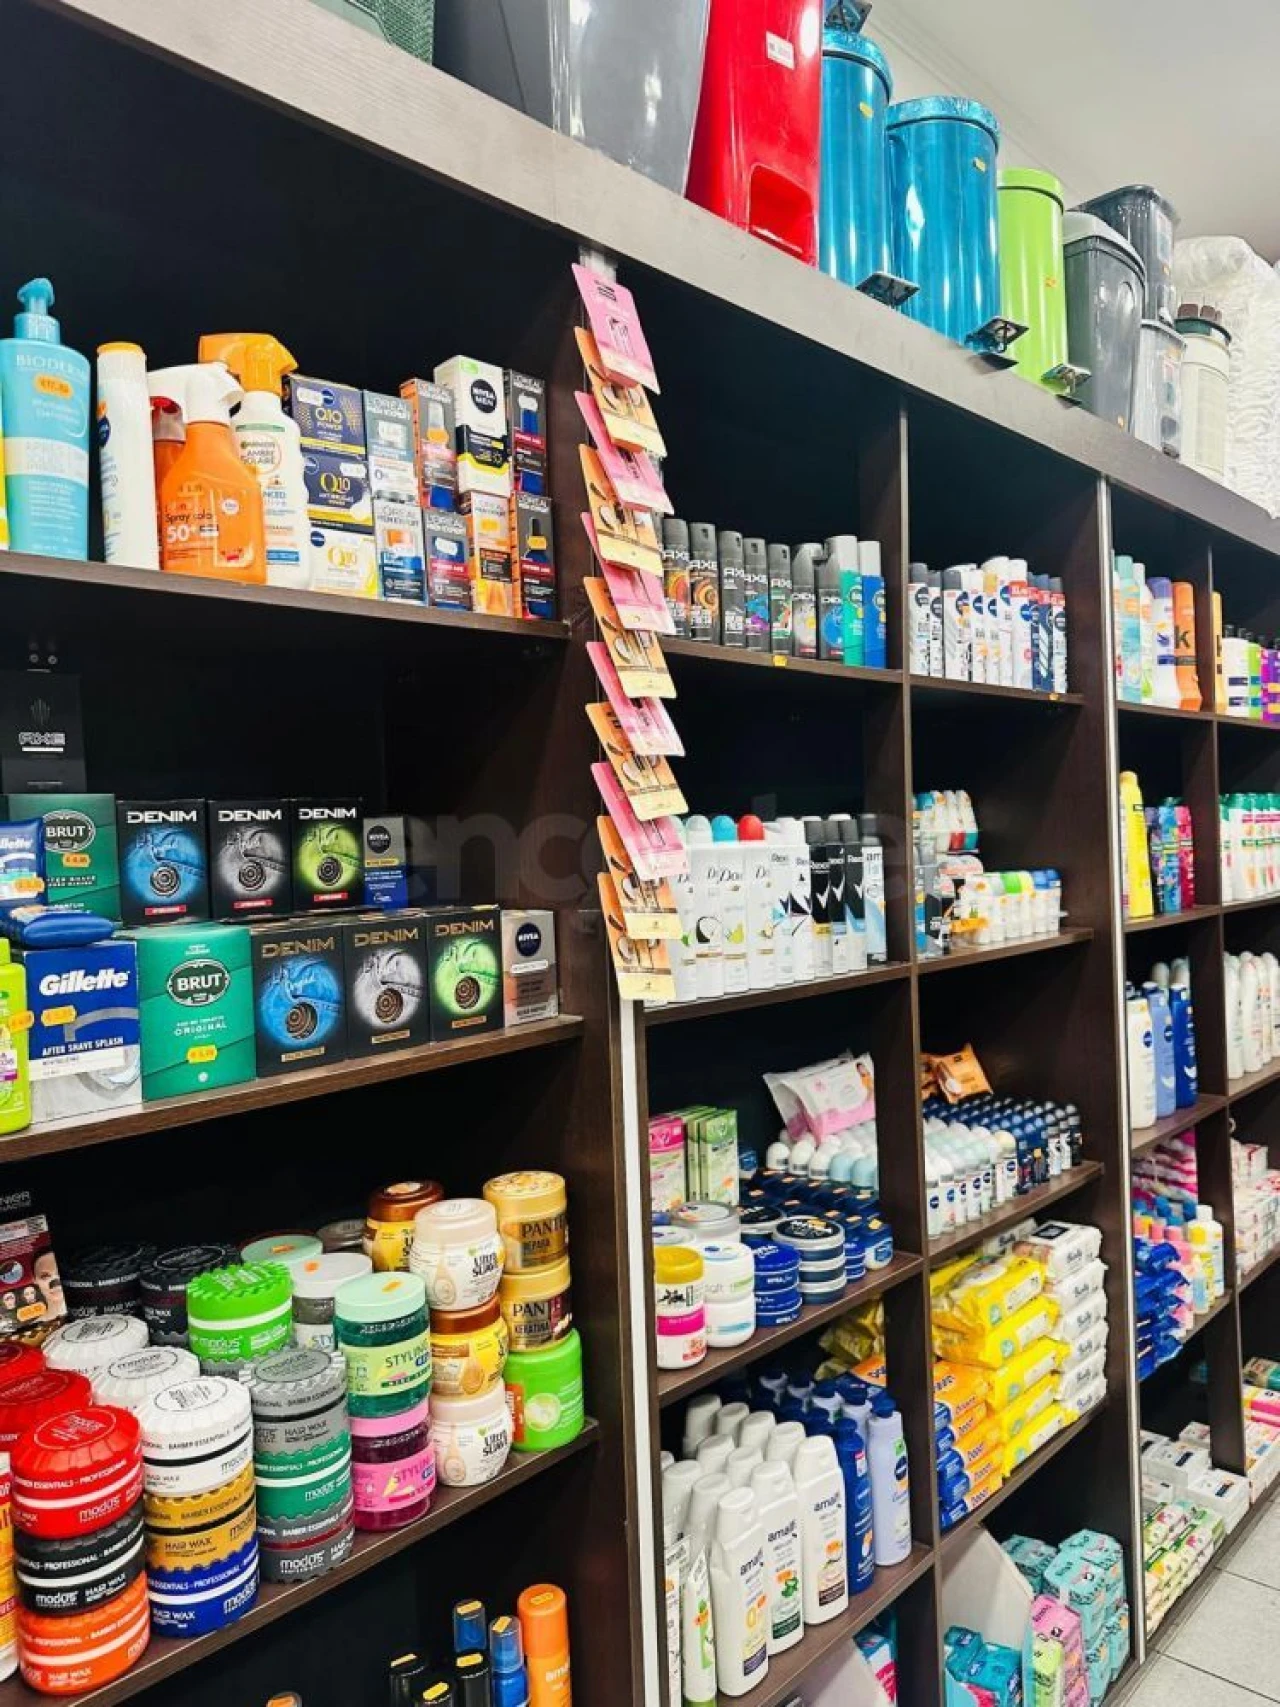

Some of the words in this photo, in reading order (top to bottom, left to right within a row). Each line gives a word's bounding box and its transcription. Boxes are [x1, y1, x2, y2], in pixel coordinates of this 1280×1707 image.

[476, 395, 493, 406] MEN
[165, 512, 190, 525] Spray
[127, 810, 197, 823] DENIM
[218, 809, 282, 821] DENIM
[299, 806, 357, 819] DENIM
[47, 826, 85, 838] BRUT
[368, 833, 390, 842] NIVEA
[434, 919, 494, 936] DENIM
[354, 928, 418, 947] DENIM
[518, 932, 539, 943] NIVEA
[262, 936, 334, 958] DENIM
[39, 968, 130, 995] Gillette
[176, 974, 222, 991] BRUT
[174, 1022, 227, 1037] ORIGINAL
[42, 1045, 64, 1057] AFTER
[67, 1041, 94, 1053] SHAVE
[95, 1037, 124, 1049] SPLASH
[284, 1426, 305, 1436] HAIR
[165, 1542, 187, 1550] HAIR
[189, 1537, 212, 1549] WAX
